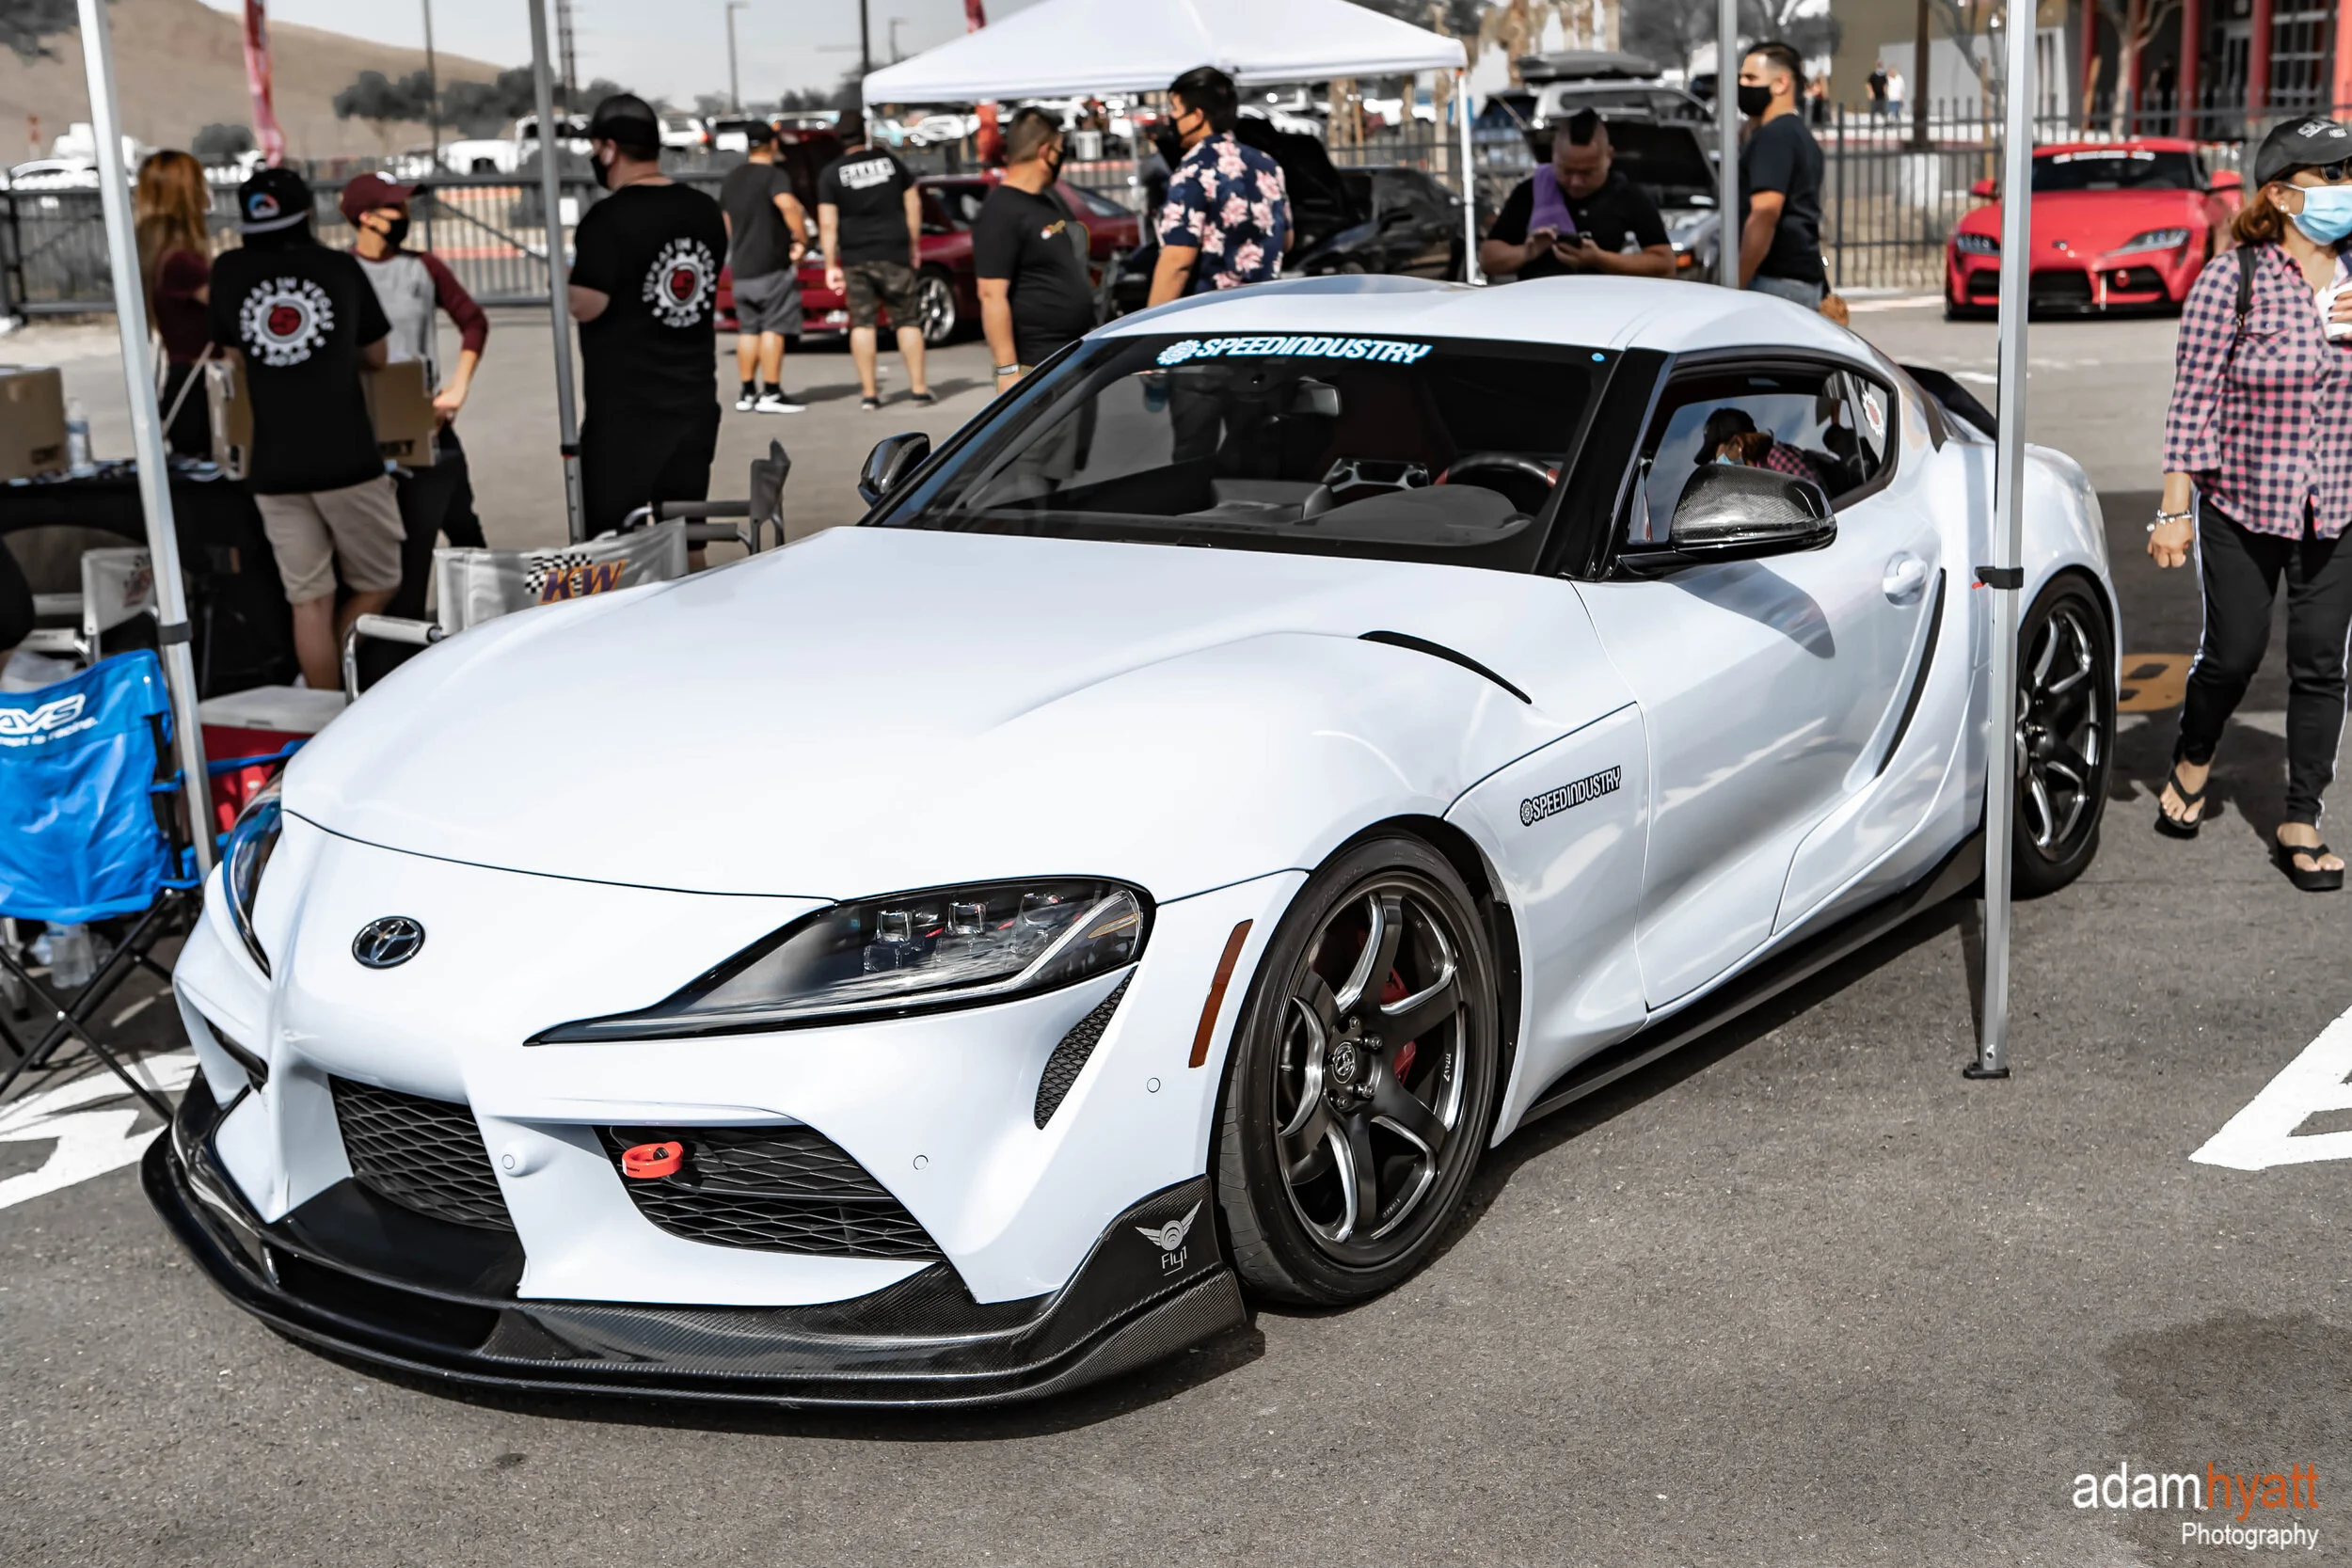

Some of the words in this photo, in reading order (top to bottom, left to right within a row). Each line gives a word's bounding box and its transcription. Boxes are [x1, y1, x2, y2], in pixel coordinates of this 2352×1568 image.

[1196, 336, 1434, 365] SPEEDINDUSTRY
[539, 559, 628, 605] KW
[1532, 766, 1621, 821] SPEEDINDUSTRY
